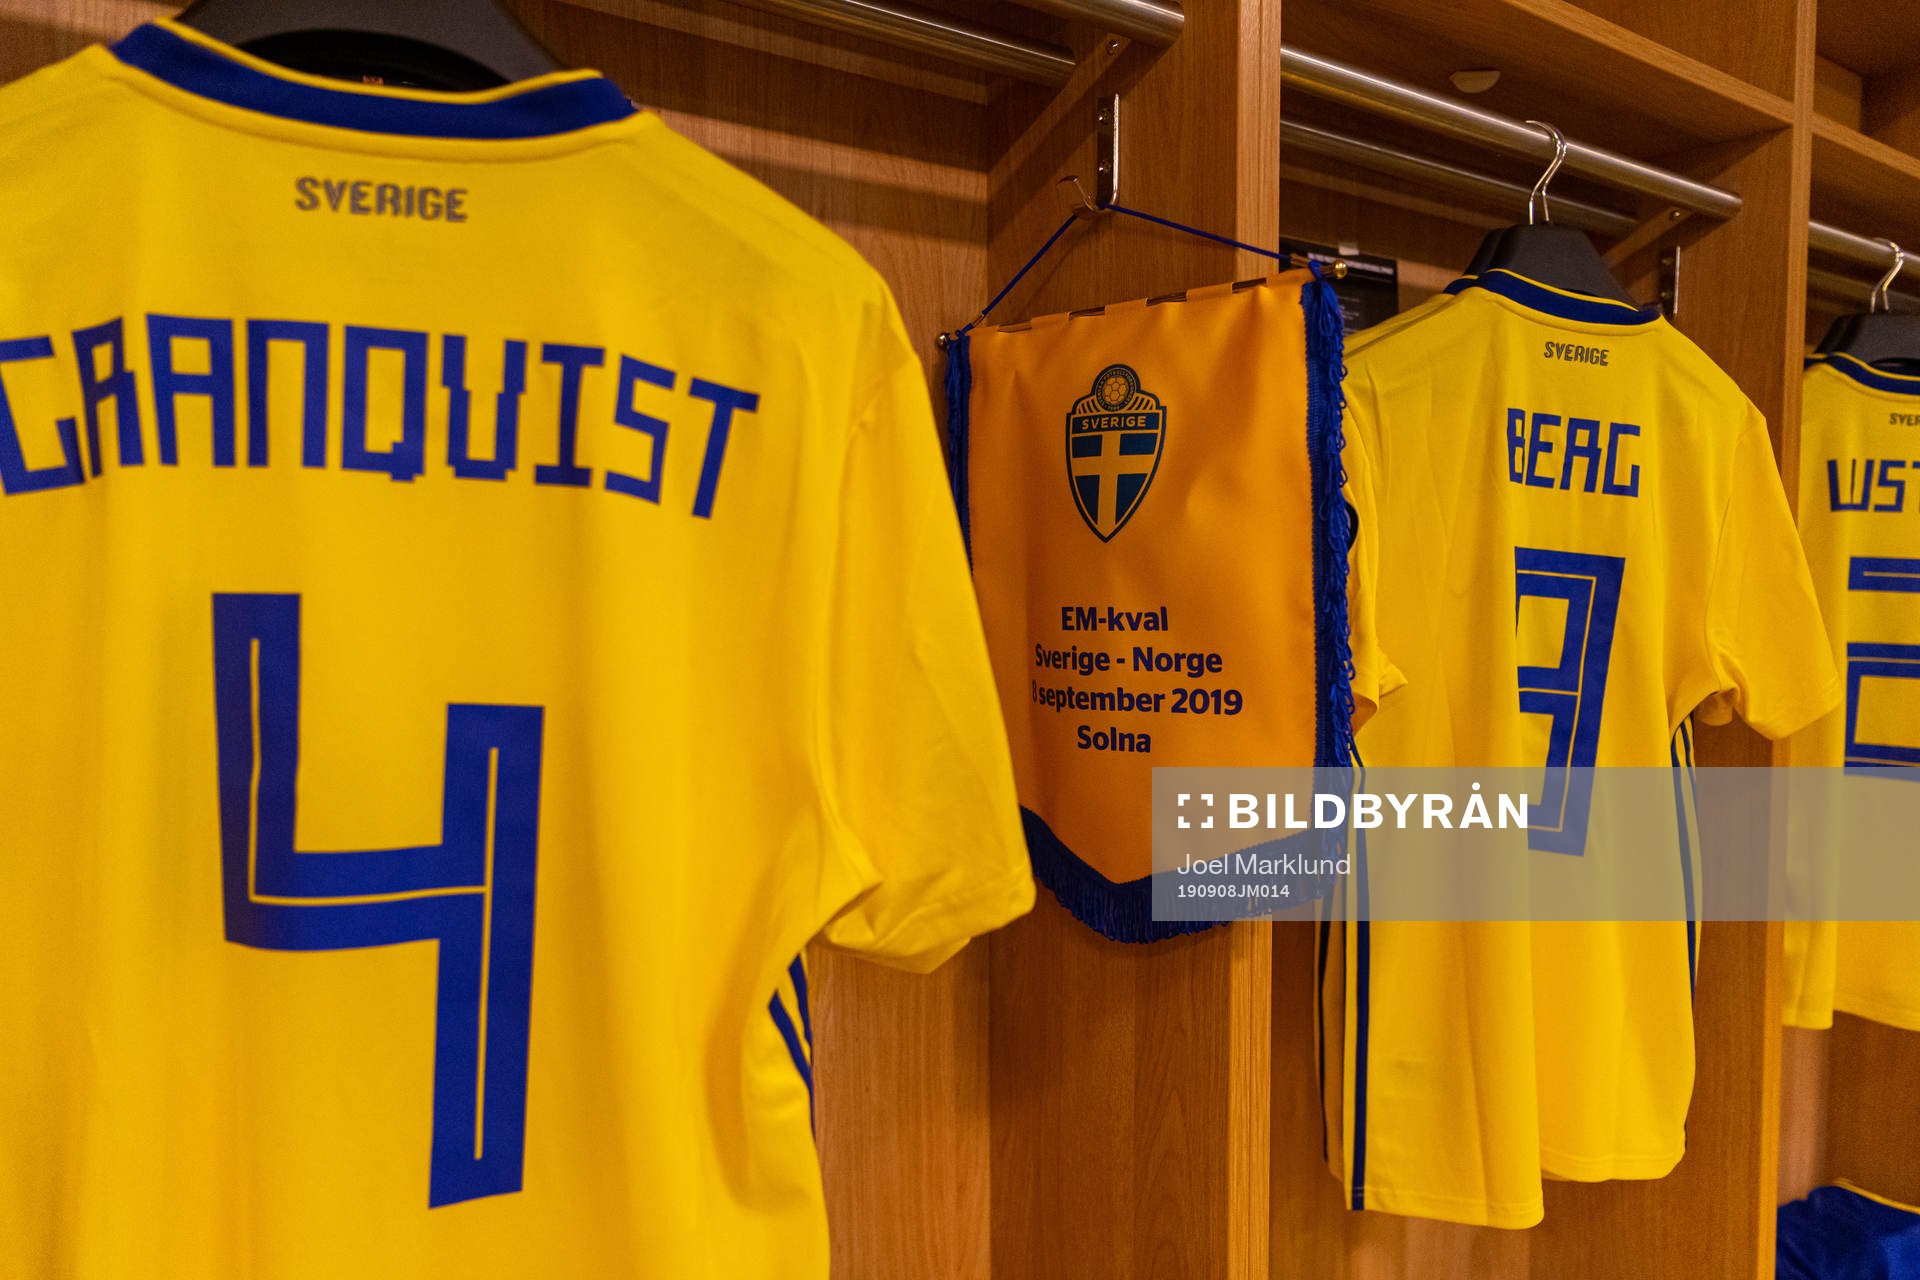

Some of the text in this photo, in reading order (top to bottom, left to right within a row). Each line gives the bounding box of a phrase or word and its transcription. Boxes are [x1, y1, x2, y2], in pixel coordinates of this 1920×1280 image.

[295, 175, 469, 223] SVERIGE
[1544, 341, 1610, 367] SVERIGE
[1081, 415, 1147, 431] SVERIGE
[1507, 408, 1641, 498] BERG
[1061, 606, 1169, 632] EM-kval
[1035, 643, 1223, 679] Sverige - Norge
[1039, 686, 1166, 713] september
[1171, 688, 1244, 716] 2019
[1514, 546, 1626, 857] 9
[1077, 725, 1152, 753] Solna
[211, 592, 545, 1210] 4
